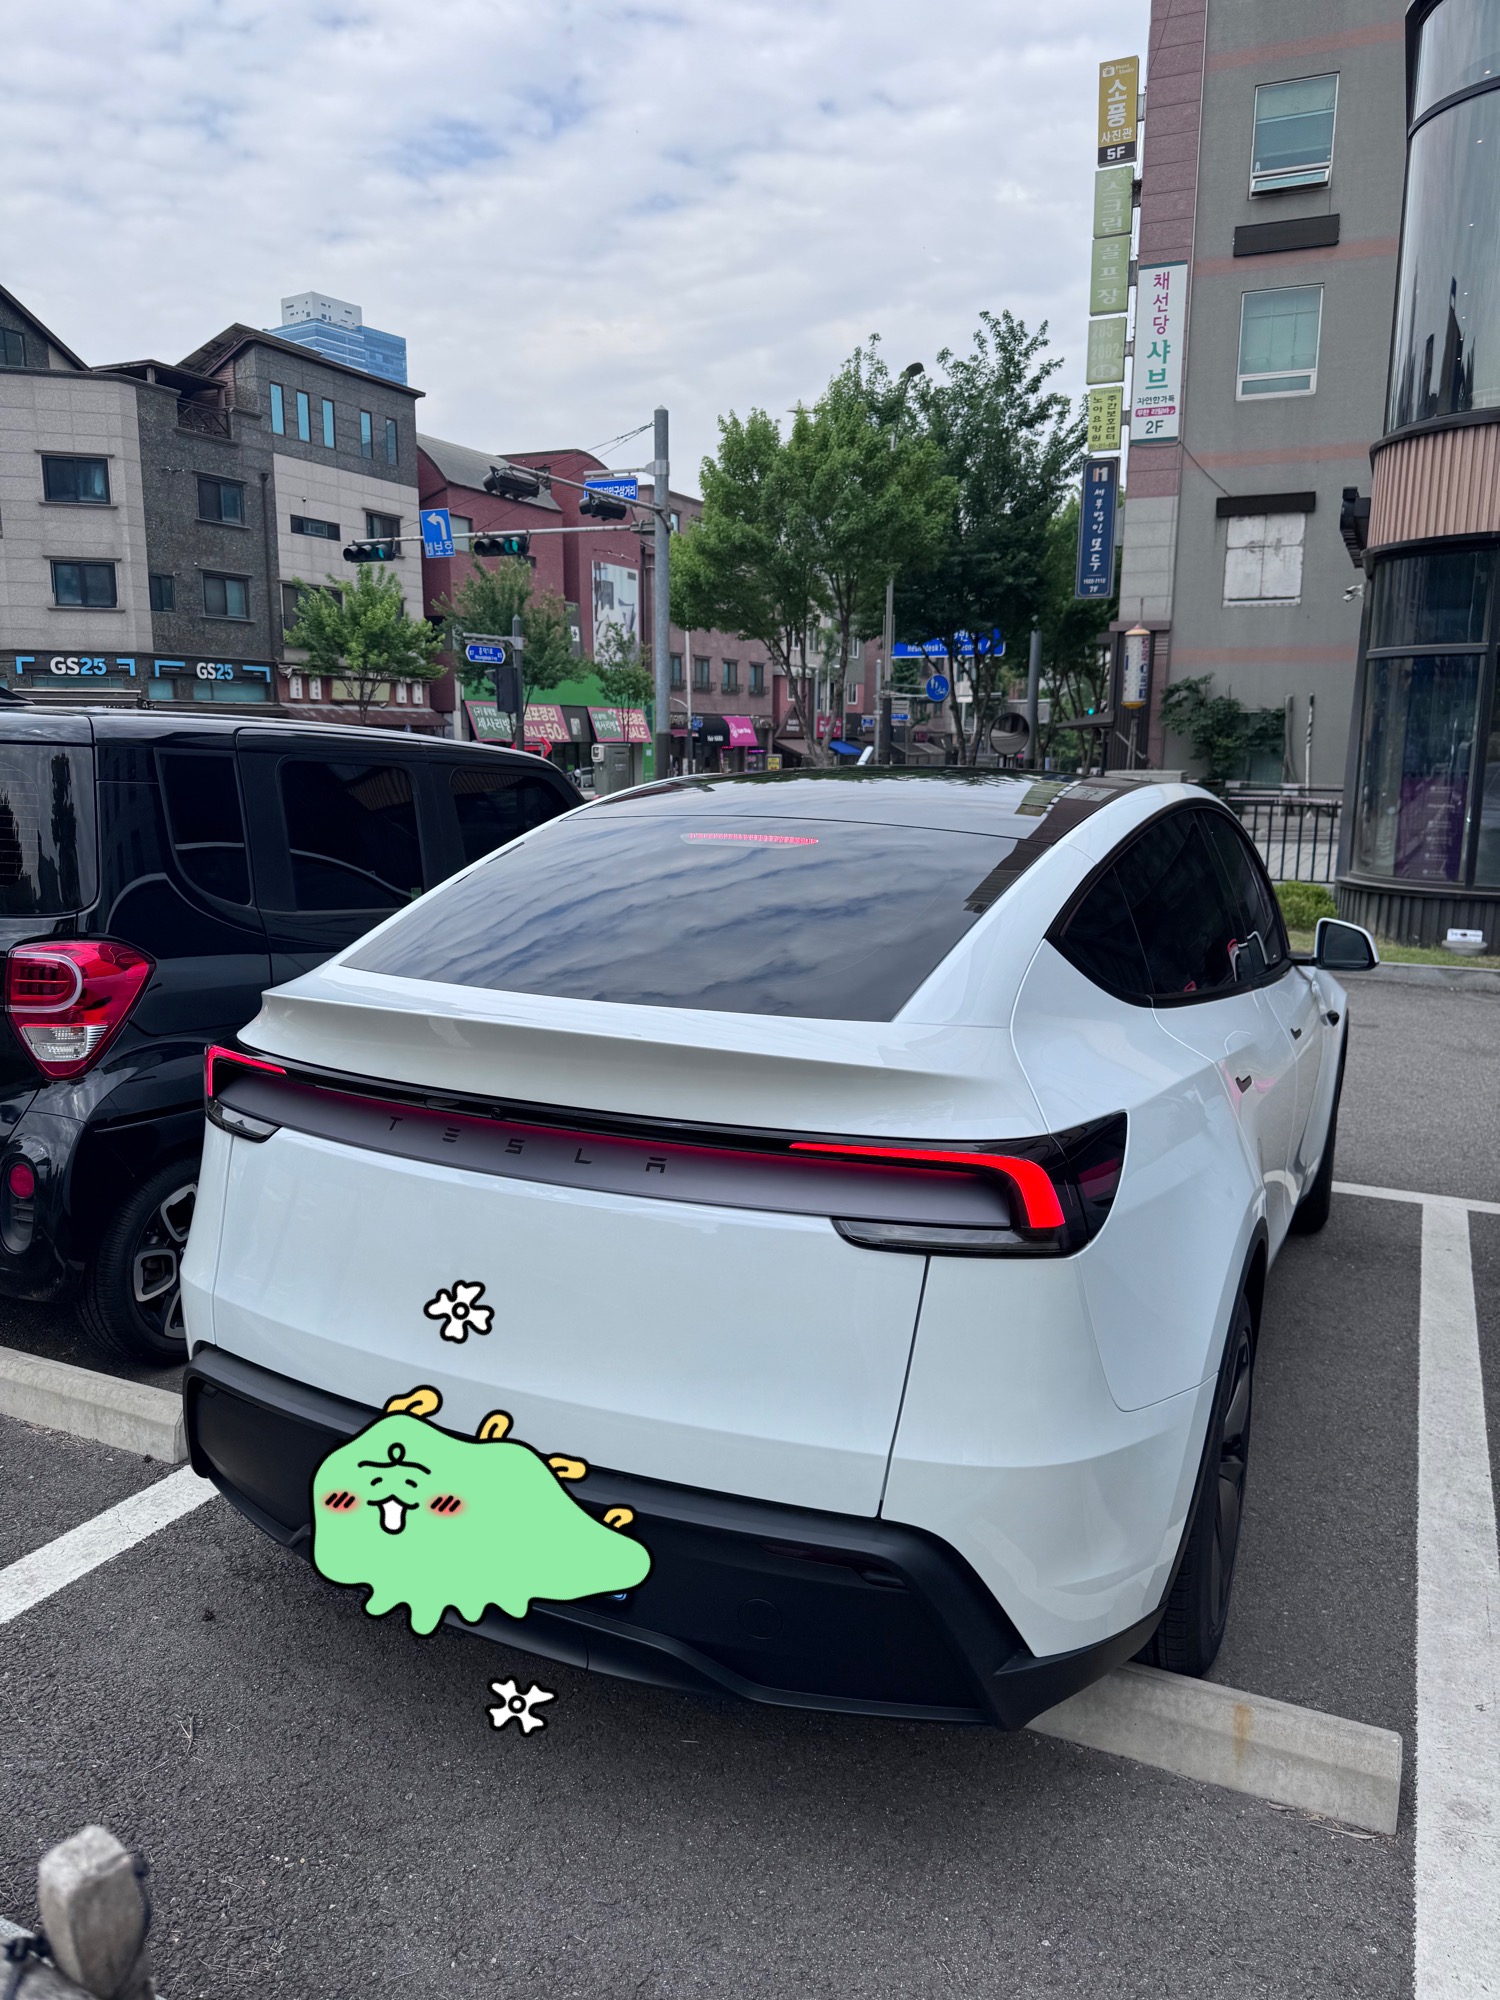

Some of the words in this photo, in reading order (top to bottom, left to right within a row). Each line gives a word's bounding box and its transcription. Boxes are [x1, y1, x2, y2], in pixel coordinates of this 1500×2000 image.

[1106, 79, 1128, 128] 소풍
[1101, 127, 1133, 144] 사진관
[1106, 146, 1126, 160] 5F
[1102, 182, 1124, 233] 스크린
[1097, 243, 1121, 304] 골프장
[1153, 271, 1170, 335] 채선당
[1145, 339, 1171, 389] 샤브
[1092, 396, 1103, 442] 노아요양원
[1106, 395, 1117, 440] 주간보호센터
[1145, 419, 1164, 434] 2F
[1092, 488, 1105, 534] 세무법인
[426, 540, 454, 556] 비보호
[1088, 537, 1103, 572] 모두
[50, 656, 107, 675] GS25
[196, 662, 234, 680] GS25
[524, 726, 547, 738] SALE
[389, 1115, 668, 1174] TESLA
